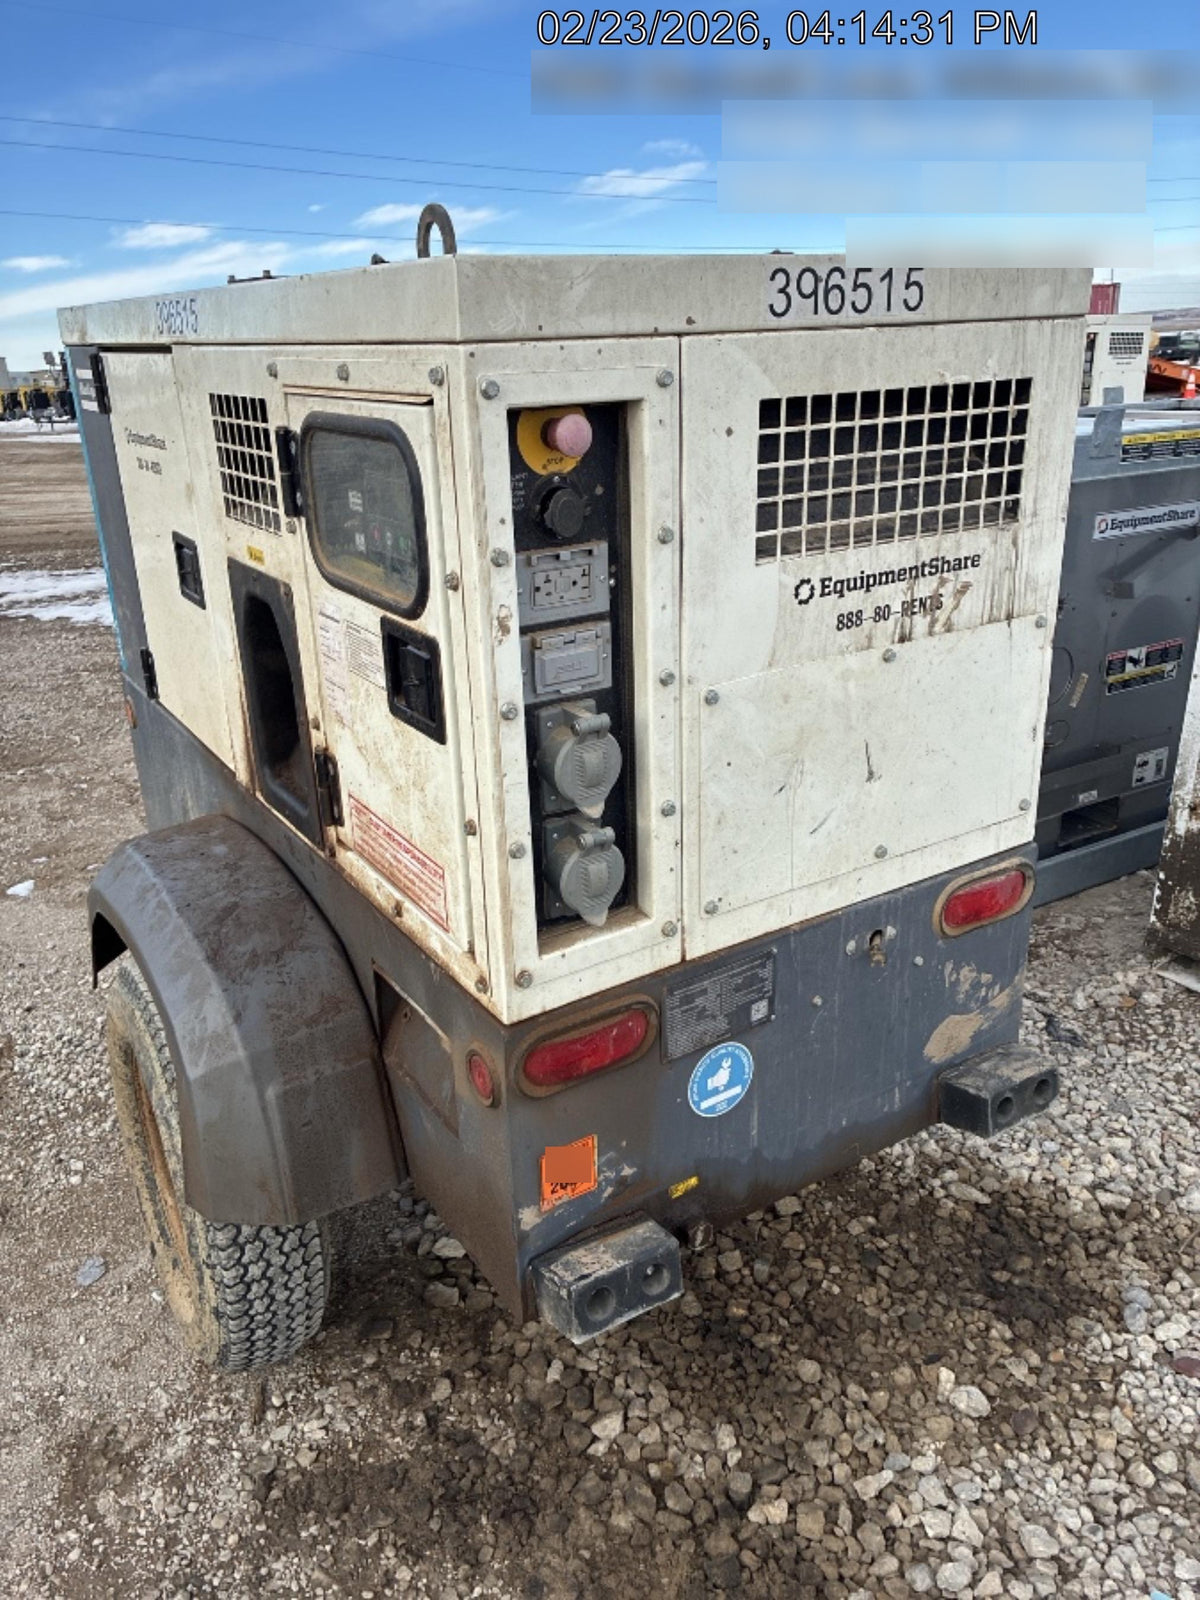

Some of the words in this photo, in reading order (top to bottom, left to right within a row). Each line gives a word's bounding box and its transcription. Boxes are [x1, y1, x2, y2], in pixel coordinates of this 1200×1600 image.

[768, 265, 925, 318] 396515
[155, 298, 198, 335] 396515
[1109, 509, 1196, 532] EquipmentShare
[818, 553, 982, 598] EquipmentShare
